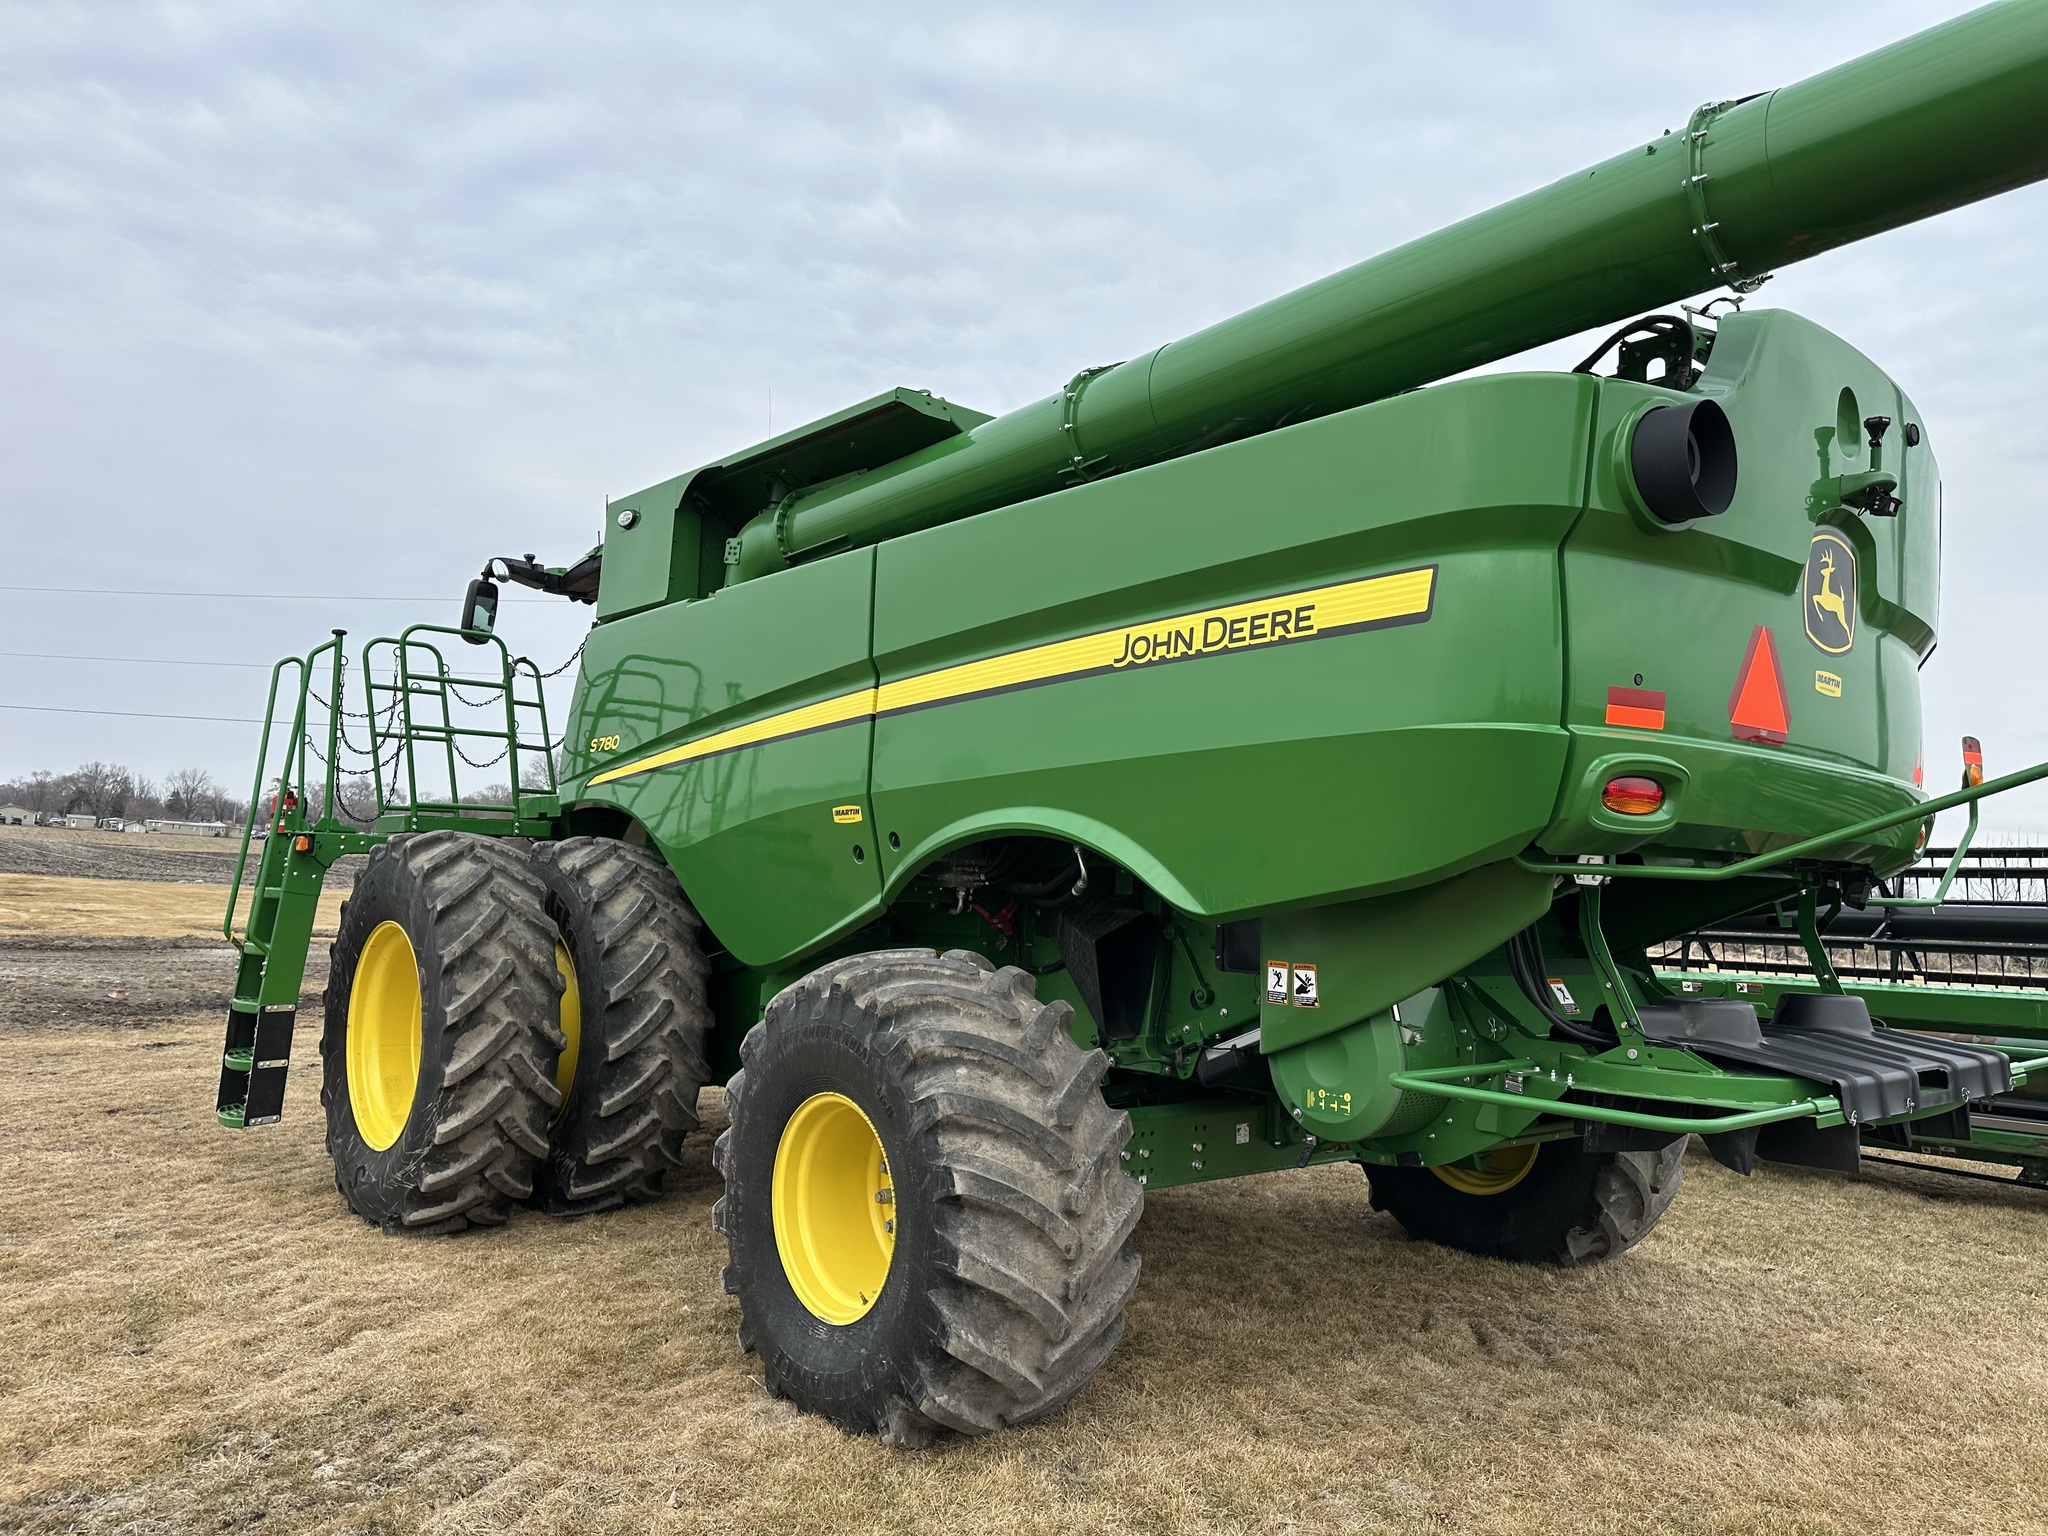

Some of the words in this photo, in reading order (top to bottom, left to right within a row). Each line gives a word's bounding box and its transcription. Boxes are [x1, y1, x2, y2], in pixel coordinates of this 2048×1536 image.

[1113, 628, 1195, 665] JOHN
[1202, 604, 1317, 650] DEERE
[1817, 673, 1840, 688] MARTIN
[589, 734, 621, 753] S780
[834, 808, 860, 817] MARTIN
